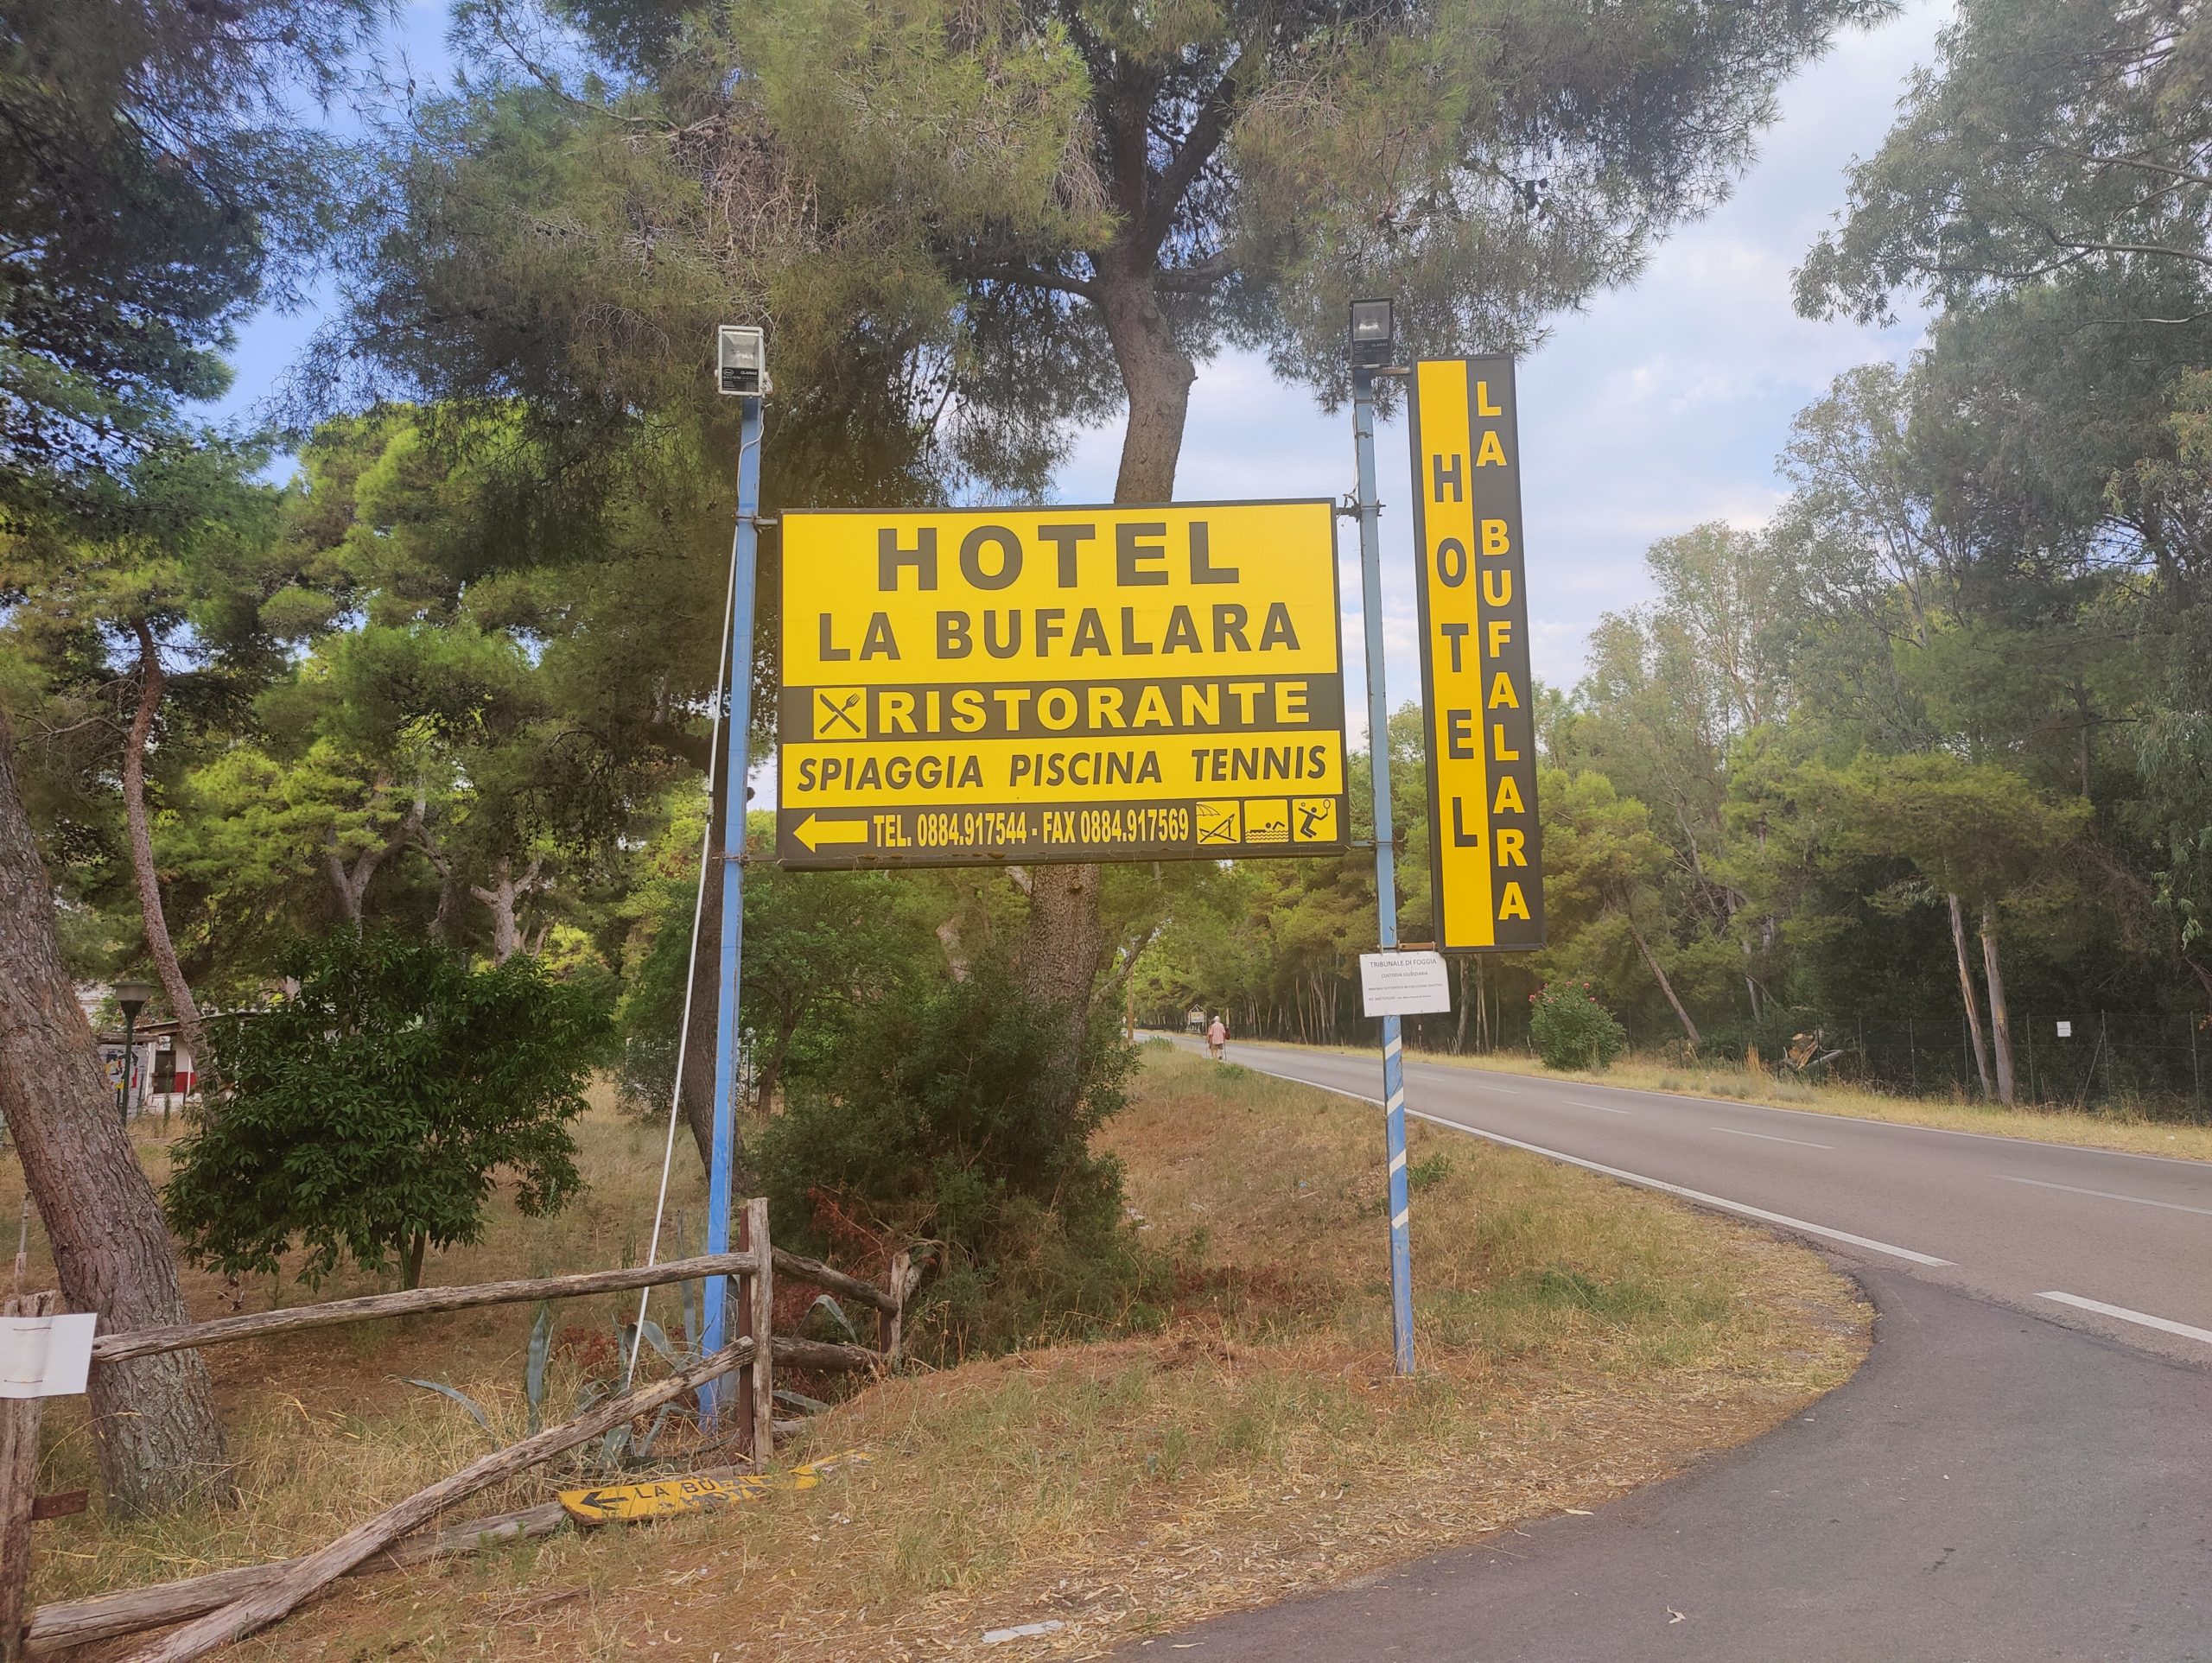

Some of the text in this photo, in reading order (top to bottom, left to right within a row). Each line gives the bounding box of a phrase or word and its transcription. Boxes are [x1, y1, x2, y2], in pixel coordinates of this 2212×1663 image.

[878, 521, 1240, 592] HOTEL
[818, 602, 1301, 663] LA BUFALARA
[1433, 454, 1478, 847] HOTEL
[1476, 381, 1531, 920] LA BUFALARA
[878, 681, 1311, 734] RISTORANTE
[797, 745, 1326, 792] SPIAGGIA PISCINA TENNIS
[873, 815, 912, 847] TEL.
[917, 811, 1027, 847] 0884.917544
[1043, 810, 1076, 844] FAX
[1080, 808, 1189, 844] 0884.917569
[634, 1485, 671, 1499] LA
